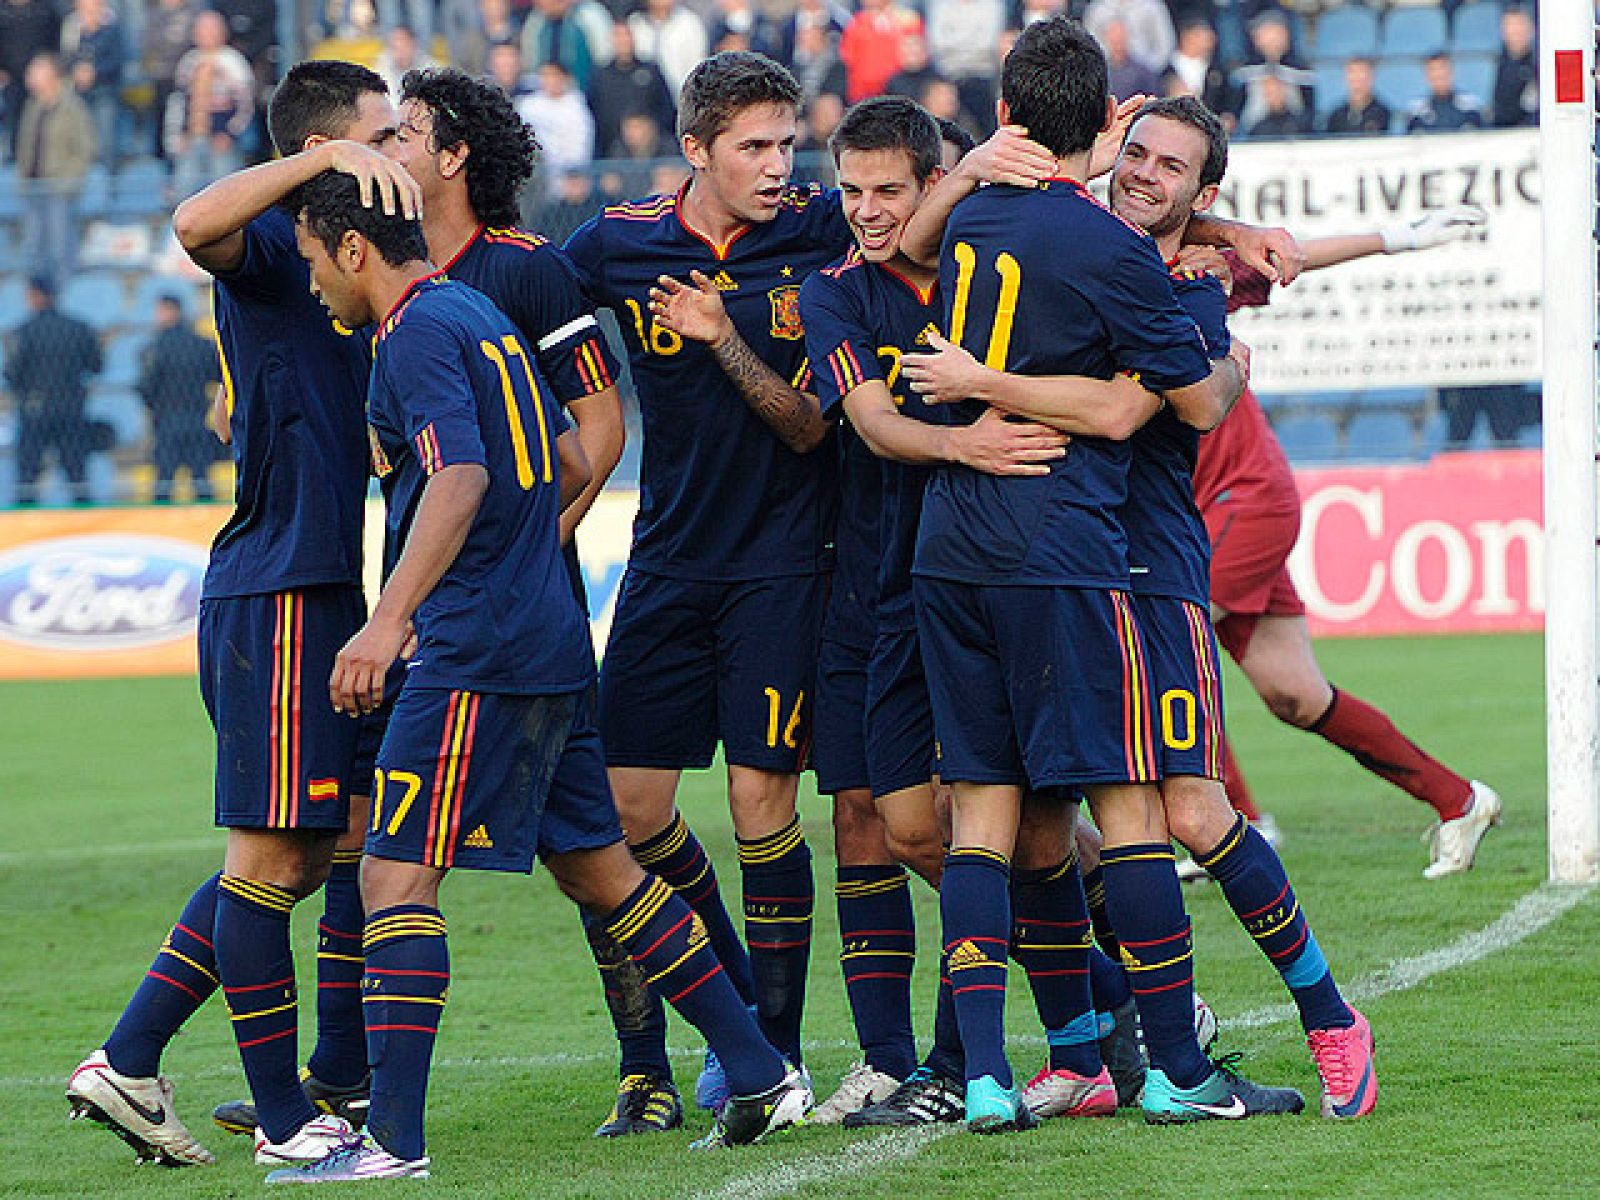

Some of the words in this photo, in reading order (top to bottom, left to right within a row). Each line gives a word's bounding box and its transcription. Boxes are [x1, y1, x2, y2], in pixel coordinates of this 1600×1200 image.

[949, 242, 1021, 373] 11
[480, 335, 553, 490] 17
[9, 554, 190, 630] Ford
[1285, 484, 1545, 622] Con
[371, 768, 422, 836] 17
